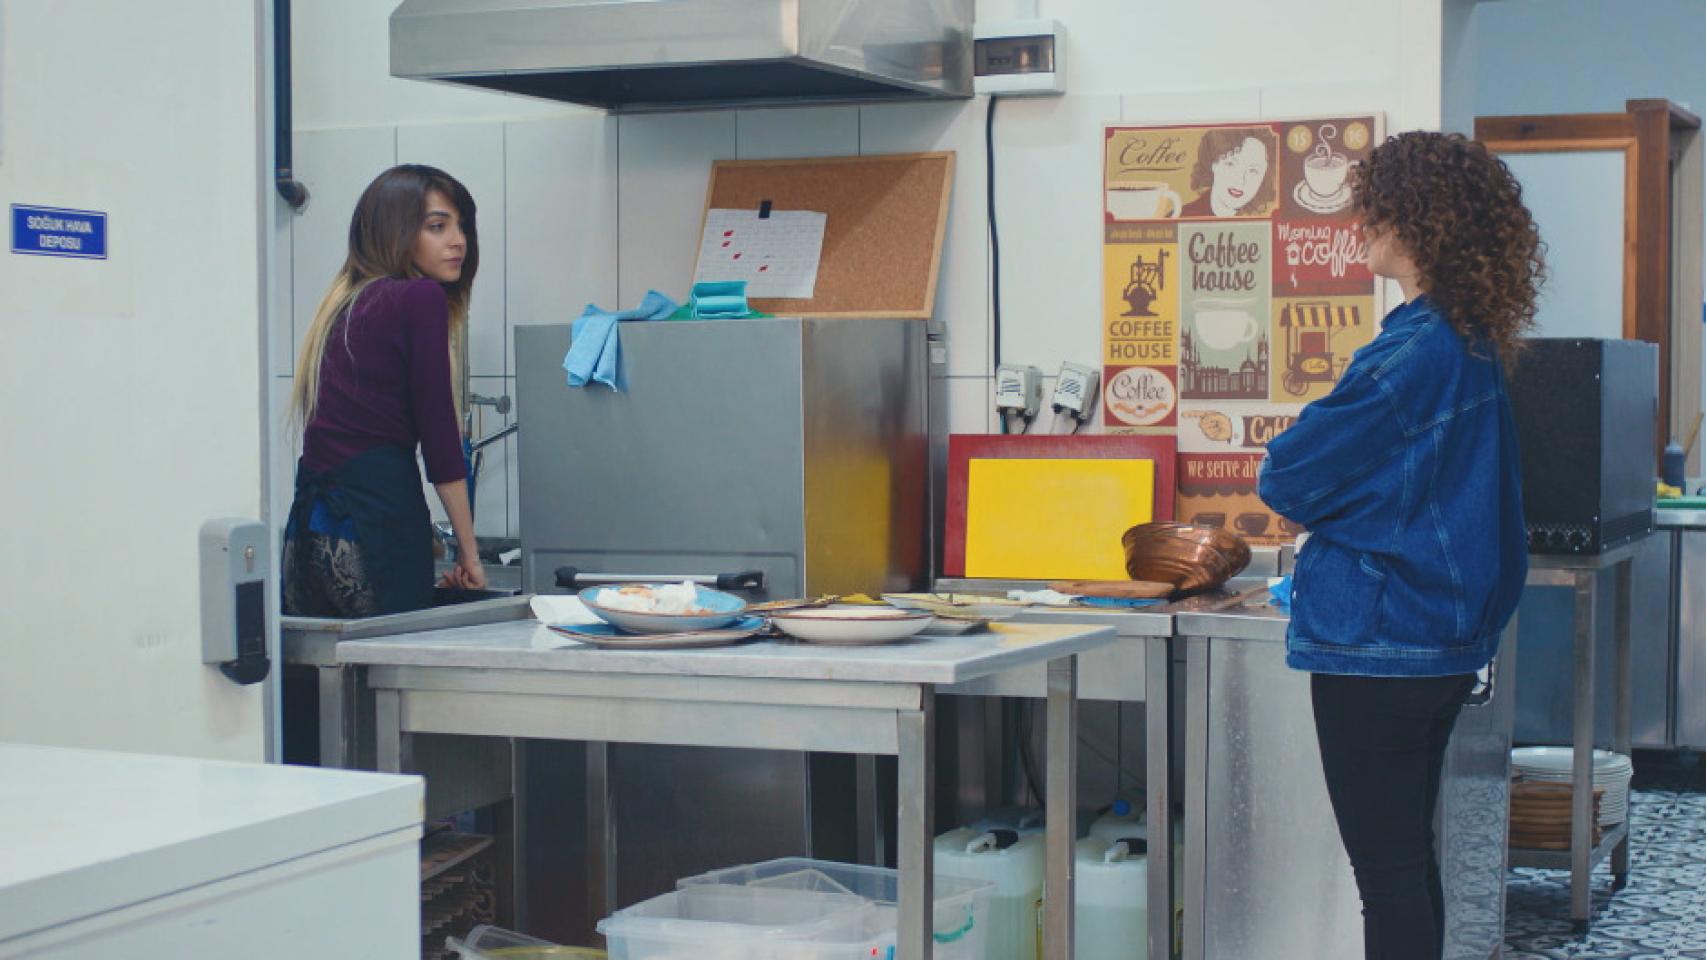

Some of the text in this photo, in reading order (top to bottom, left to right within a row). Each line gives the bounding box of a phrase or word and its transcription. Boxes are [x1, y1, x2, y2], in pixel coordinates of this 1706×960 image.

[1118, 135, 1188, 166] Coffee
[26, 214, 92, 233] SOĞUK HAVA
[39, 233, 82, 250] DEPOSU
[1188, 231, 1262, 268] Coffee
[1192, 264, 1257, 292] house
[1109, 320, 1172, 337] COFFEE
[1109, 343, 1172, 359] HOUSE
[1111, 368, 1165, 401] Coffee
[1187, 459, 1204, 478] we
[1206, 459, 1240, 479] serve
